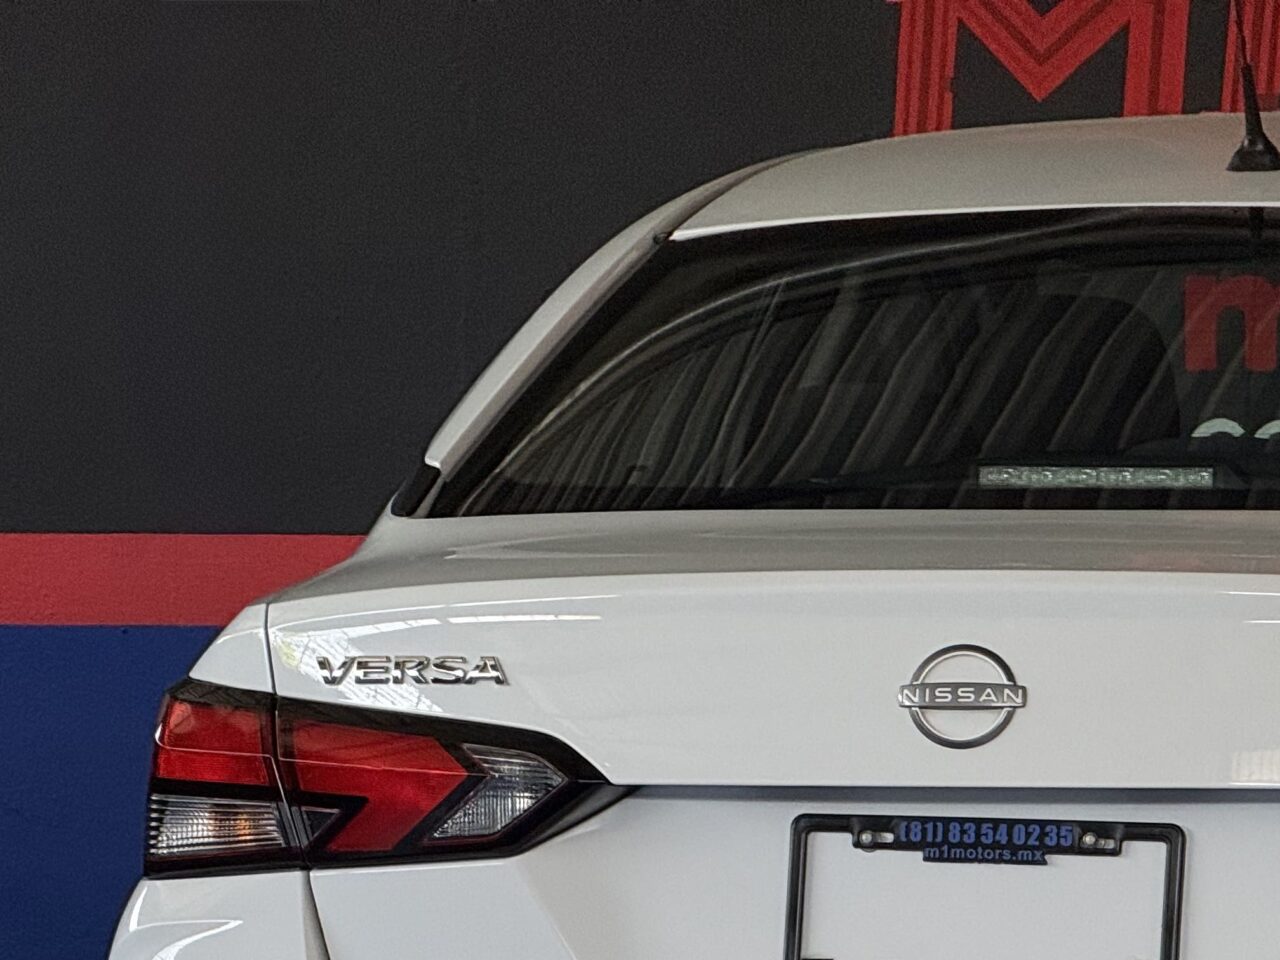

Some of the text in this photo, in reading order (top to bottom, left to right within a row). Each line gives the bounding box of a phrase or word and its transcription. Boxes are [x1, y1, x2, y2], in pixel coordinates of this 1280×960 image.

[316, 655, 510, 686] VERSA
[902, 687, 1023, 704] NISSAN
[901, 821, 943, 842] (81)
[924, 845, 1044, 862] m1motors.mx
